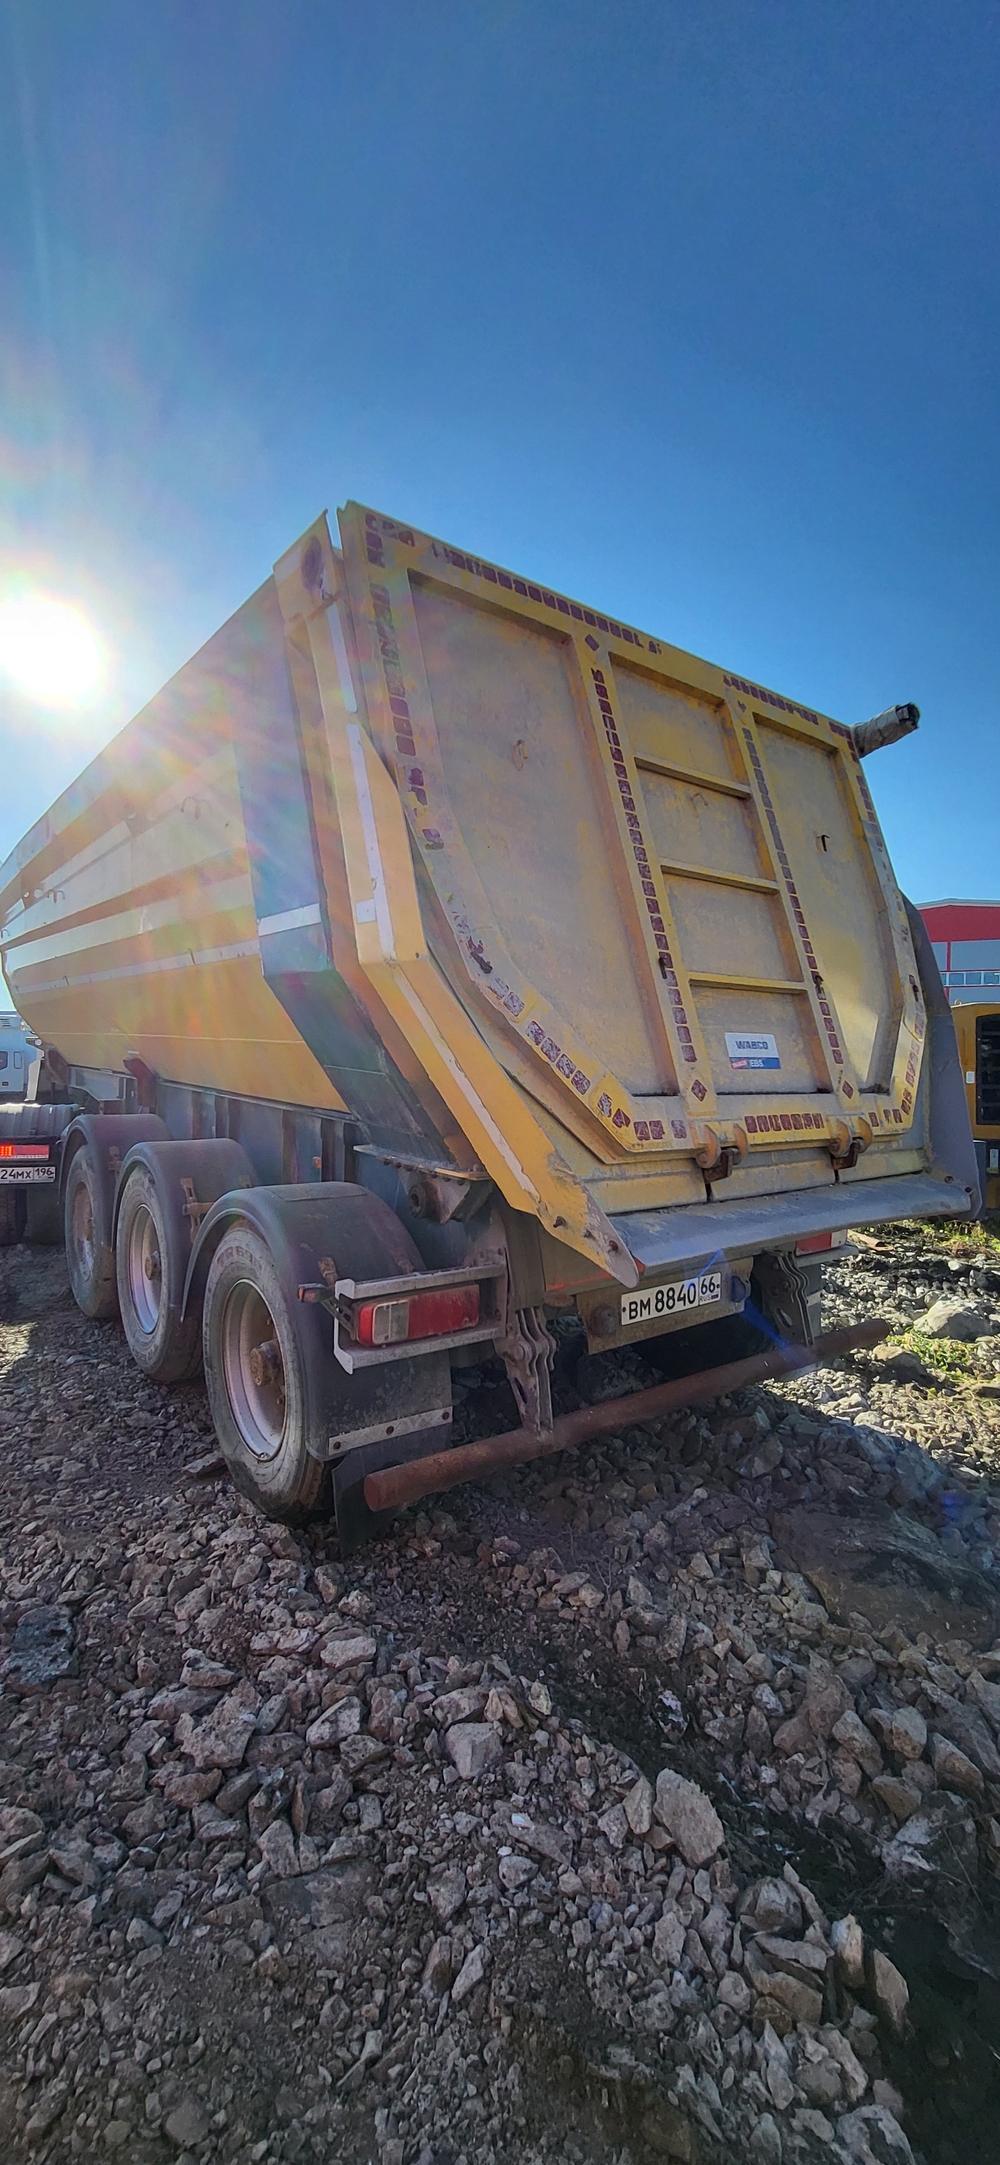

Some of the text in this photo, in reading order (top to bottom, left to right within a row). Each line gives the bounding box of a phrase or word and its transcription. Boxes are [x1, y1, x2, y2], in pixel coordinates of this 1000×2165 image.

[735, 1040, 769, 1050] WABCO
[749, 1059, 764, 1068] EBS
[34, 1167, 54, 1177] 196
[700, 1276, 716, 1295] 66
[700, 1294, 711, 1302] RUS
